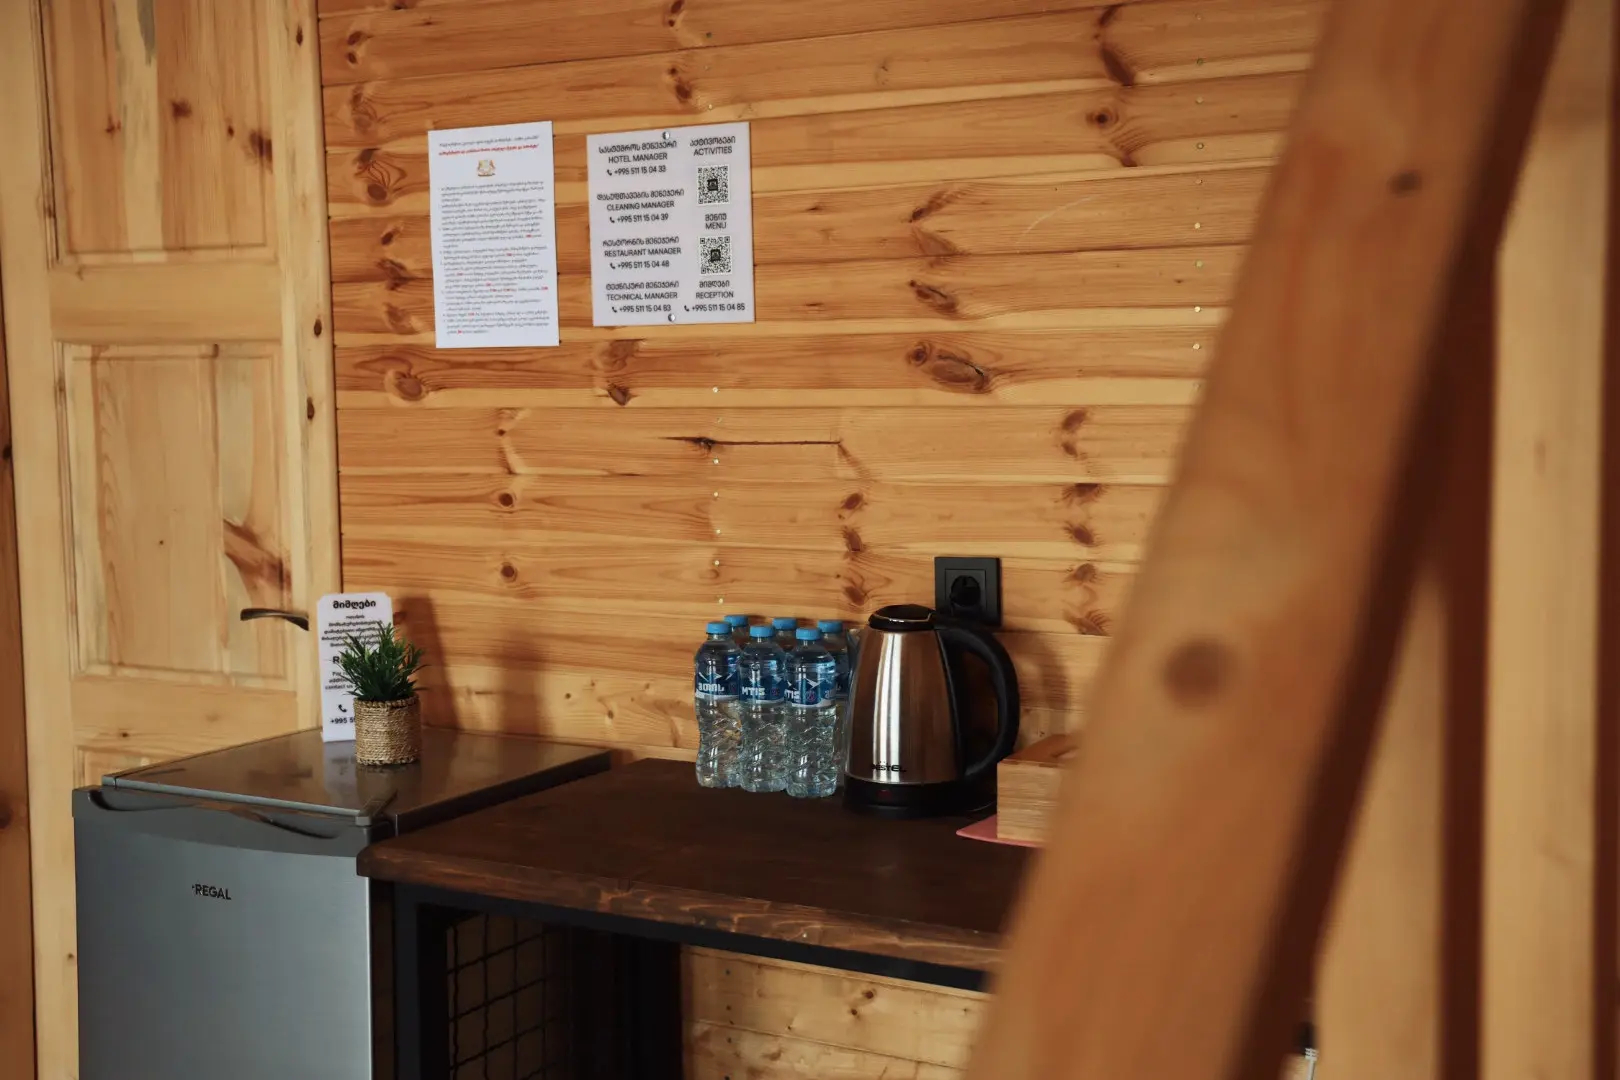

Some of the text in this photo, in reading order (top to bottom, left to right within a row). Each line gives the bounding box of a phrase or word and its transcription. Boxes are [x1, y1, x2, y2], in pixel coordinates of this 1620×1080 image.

[693, 145, 733, 156] ACTIVITIES
[608, 152, 668, 164] HOTEL MANAGER
[614, 167, 630, 176] +995
[631, 166, 640, 174] 511
[641, 166, 648, 174] 15
[649, 165, 657, 174] 04
[606, 200, 675, 212] CLEANING MANAGER
[616, 213, 669, 224] +995 511 15 04 39
[705, 221, 727, 230] MENU
[604, 247, 682, 258] RESTAURANT MANAGER
[617, 261, 632, 270] +995
[633, 260, 642, 269] 511
[643, 260, 651, 268] 15
[652, 260, 660, 268] 04
[606, 292, 678, 302] TECHNICAL MANAGER
[695, 291, 734, 300] RECEPTION
[619, 304, 634, 313] +995
[635, 304, 644, 312] 511
[653, 304, 662, 312] 04
[691, 304, 707, 312] +995
[708, 304, 718, 312] 511
[719, 304, 726, 312] 15
[727, 304, 736, 312] 04
[332, 599, 376, 610] მიმღები
[194, 883, 232, 900] REGAL
